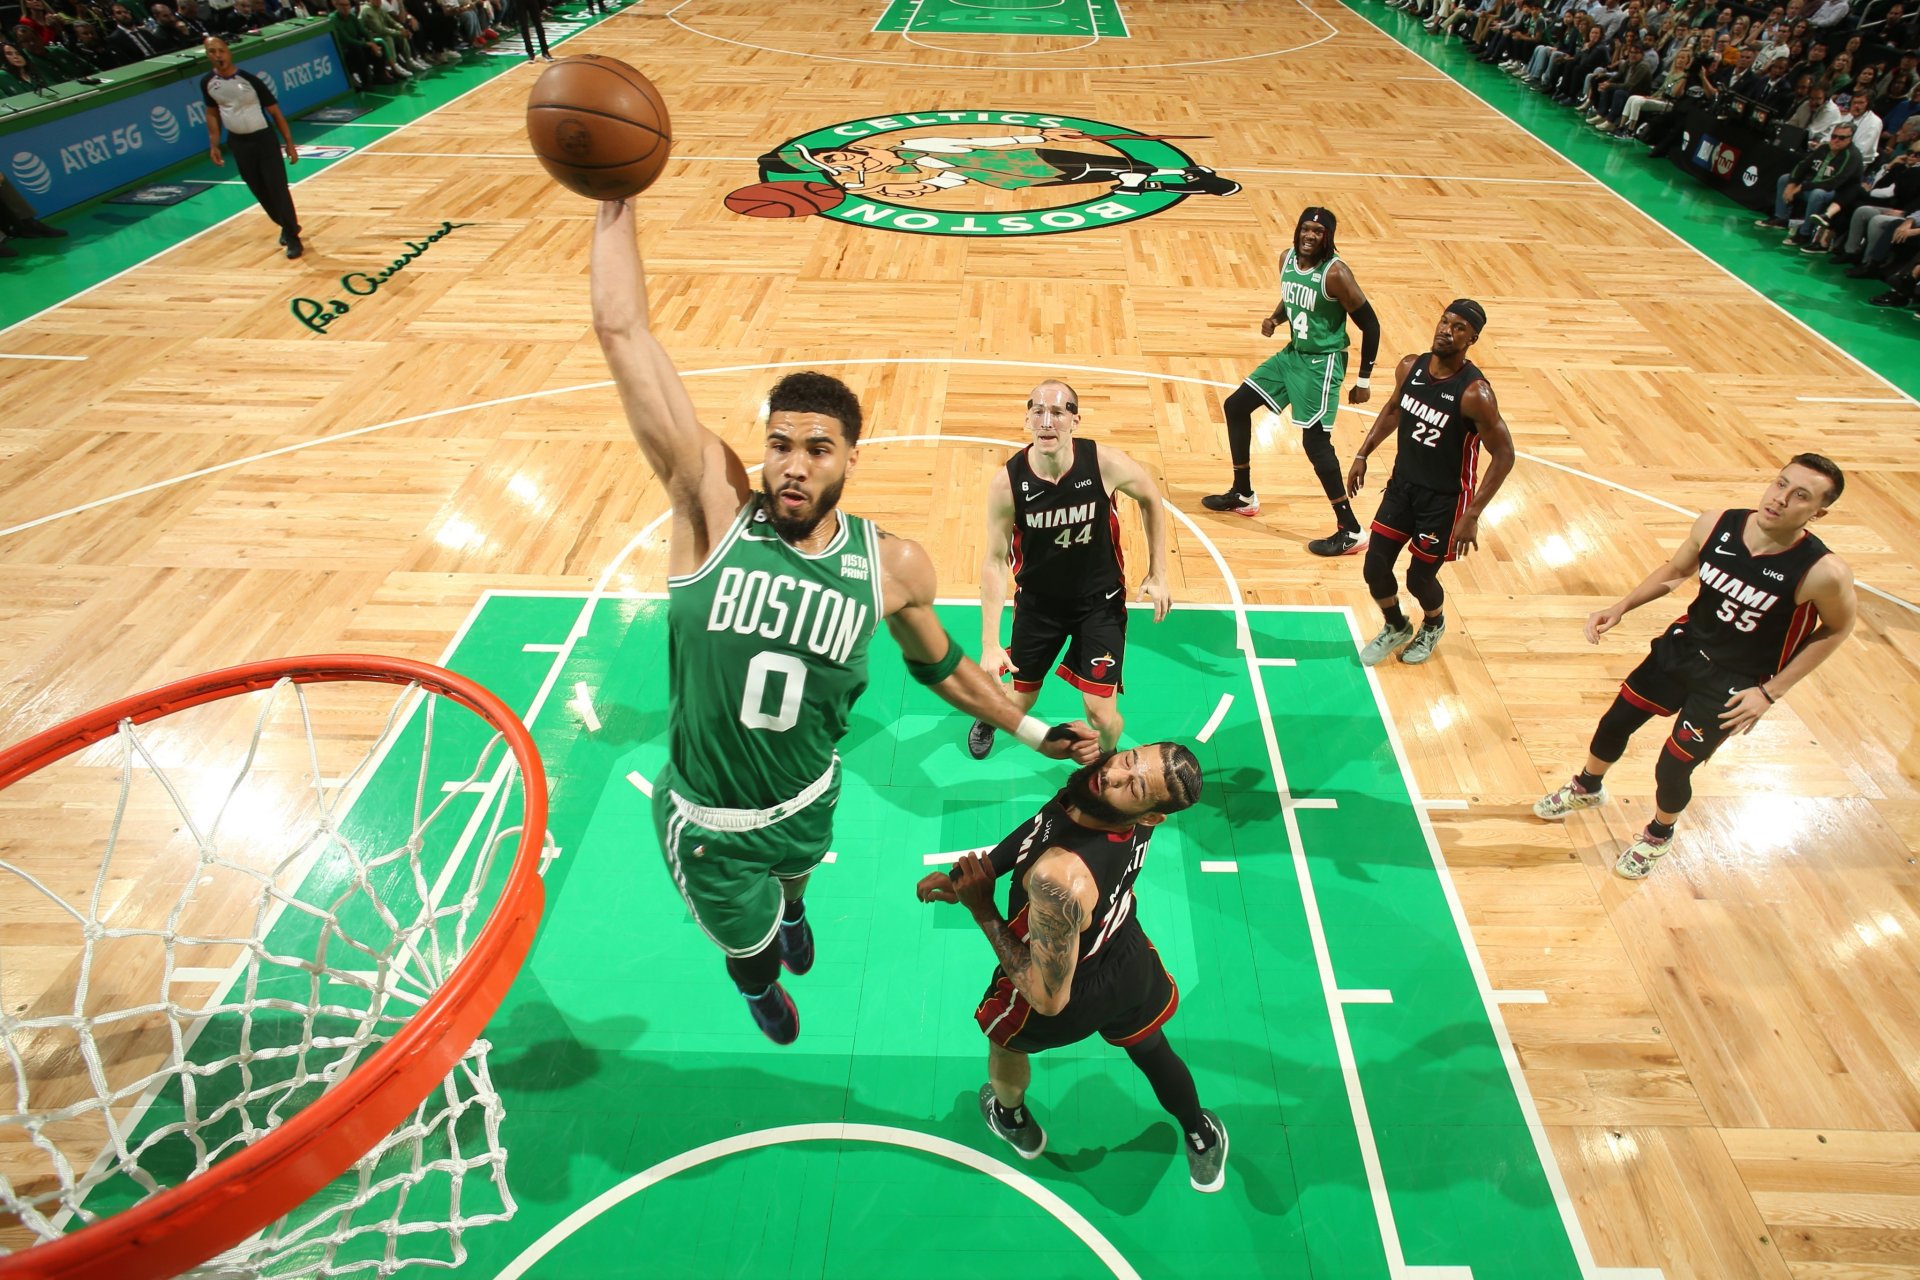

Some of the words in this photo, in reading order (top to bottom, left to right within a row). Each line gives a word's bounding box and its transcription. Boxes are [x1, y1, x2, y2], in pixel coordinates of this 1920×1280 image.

[282, 60, 314, 91] AT&T
[313, 55, 332, 79] 5G
[833, 112, 1066, 136] CELTICS
[59, 134, 112, 175] AT&T
[111, 123, 144, 156] 5G
[840, 201, 1137, 232] BOSTON
[1400, 393, 1450, 429] MIAMI
[1411, 421, 1441, 448] 22
[1021, 481, 1030, 492] 6
[1074, 478, 1093, 489] UKG
[753, 508, 768, 523] 6
[1025, 501, 1096, 529] MIAMI
[1054, 523, 1092, 549] 44
[1720, 531, 1731, 543] 6
[840, 553, 868, 571] VISTA
[840, 567, 869, 581] PRINT
[1762, 567, 1785, 582] UKG
[1698, 561, 1779, 612] MIAMI
[706, 566, 868, 664] BOSTON
[1715, 599, 1763, 633] 55
[739, 650, 808, 733] 0
